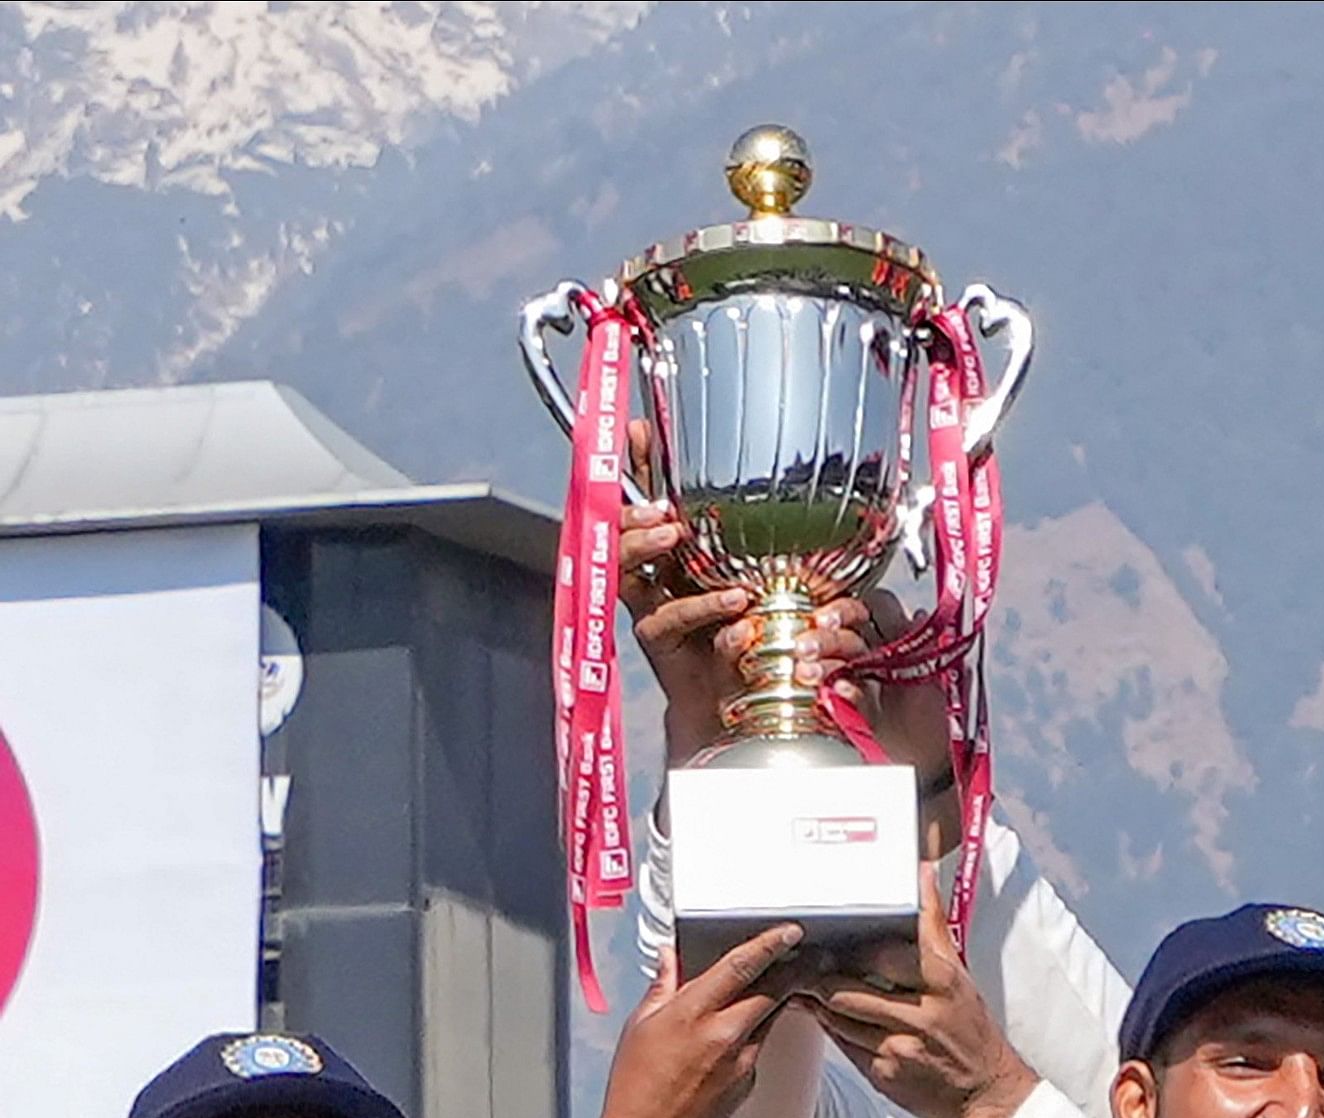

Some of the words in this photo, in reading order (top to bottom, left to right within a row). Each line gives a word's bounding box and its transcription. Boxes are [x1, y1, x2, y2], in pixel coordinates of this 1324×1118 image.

[602, 322, 621, 362] Bank
[599, 364, 618, 412] FIRST
[598, 415, 615, 452] IDFC
[941, 461, 958, 495] Bank
[942, 500, 963, 537] FIRST
[976, 512, 992, 556] FIRST
[591, 521, 609, 563] Bank
[588, 565, 606, 616] FIRST
[586, 618, 605, 660] IDFC
[580, 732, 595, 775] Bank
[600, 755, 616, 803] FIRST
[575, 777, 591, 829] FIRST
[968, 794, 984, 837] Bank
[602, 805, 620, 847] IDFC
